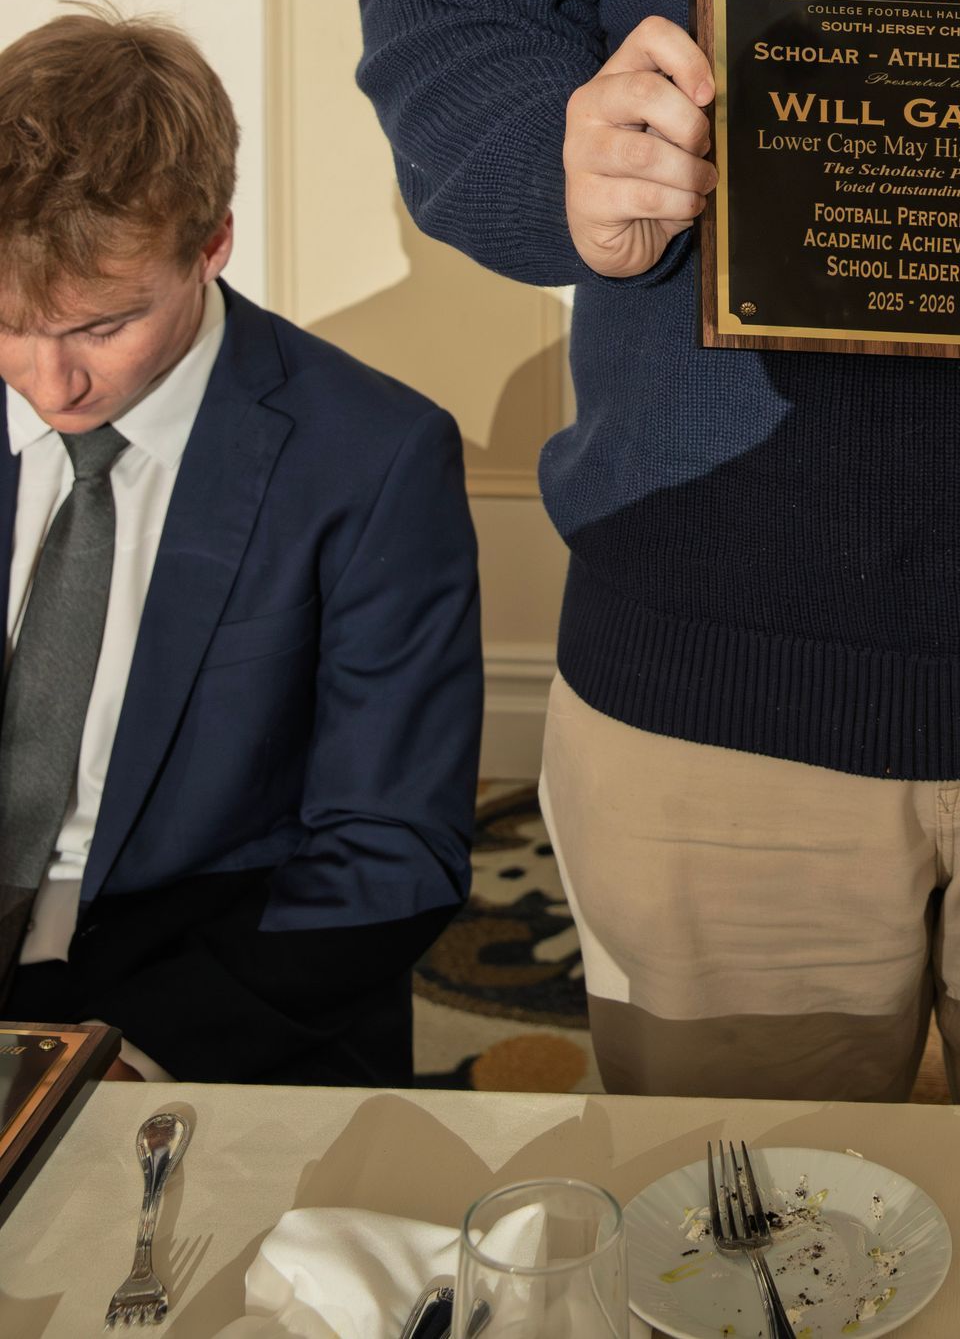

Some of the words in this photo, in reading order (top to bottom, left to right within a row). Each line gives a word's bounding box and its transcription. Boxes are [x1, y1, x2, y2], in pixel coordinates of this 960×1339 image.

[808, 5, 862, 16] COLLEGE
[868, 8, 932, 18] FOOTBALL
[822, 22, 872, 32] SOUTH
[877, 24, 936, 35] JERSEY
[754, 42, 858, 64] SCHOLAR
[865, 72, 947, 88] Presented
[769, 92, 885, 126] WILL
[758, 130, 821, 151] Lower
[827, 133, 877, 158] Cape
[884, 136, 927, 161] May
[823, 162, 855, 174] The
[859, 164, 944, 178] Scholastic
[835, 181, 874, 193] Voted
[814, 203, 891, 224] FOOTBALL
[804, 229, 892, 250] ACADEMIC
[827, 256, 892, 279] SCHOOL
[868, 292, 904, 310] 2025
[920, 294, 955, 313] 2026
